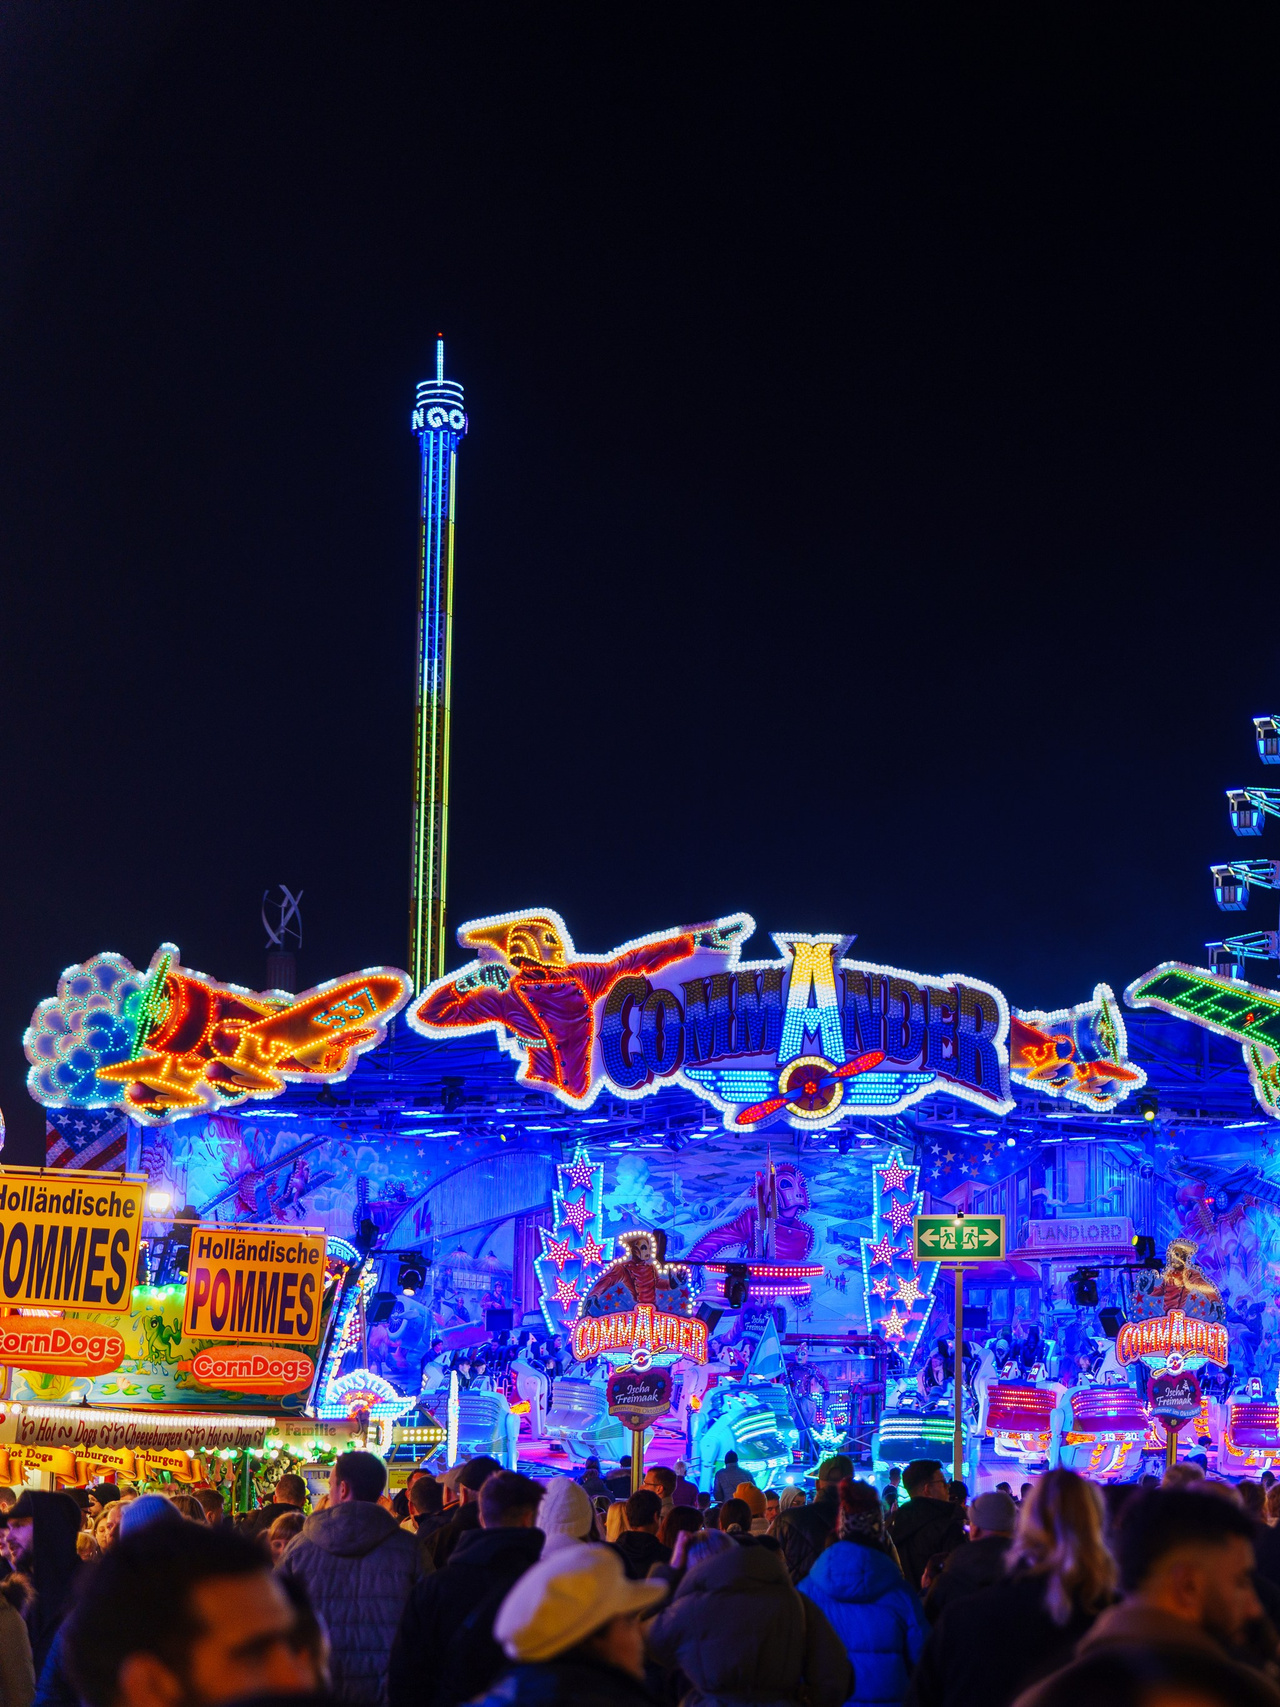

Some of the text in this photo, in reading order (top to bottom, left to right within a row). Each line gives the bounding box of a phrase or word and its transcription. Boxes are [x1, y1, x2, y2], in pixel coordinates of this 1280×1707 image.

[412, 406, 465, 430] NGO
[313, 986, 377, 1029] 537
[598, 942, 1006, 1101] COMMANDER
[1037, 1224, 1121, 1240] LANDLORD
[0, 1221, 130, 1305] OMMES
[198, 1236, 319, 1265] Holländische
[190, 1267, 315, 1337] POMMES
[0, 1327, 123, 1363] ornDogs
[575, 1305, 707, 1364] COMMANDER
[1118, 1311, 1228, 1365] COMMANDER
[193, 1355, 312, 1383] CornDogs
[327, 1371, 393, 1404] HANSTEIN
[616, 1388, 658, 1404] Freimaak
[626, 1381, 650, 1395] Ischa
[1156, 1393, 1192, 1406] Freimaak
[1165, 1384, 1184, 1397] Ischa
[36, 1416, 57, 1441] Hot
[74, 1419, 98, 1446] Dogs
[125, 1423, 182, 1447] Cheeseburgers
[285, 1423, 337, 1437] Familie
[26, 1448, 53, 1462] Dogs
[75, 1447, 124, 1464] mburgers
